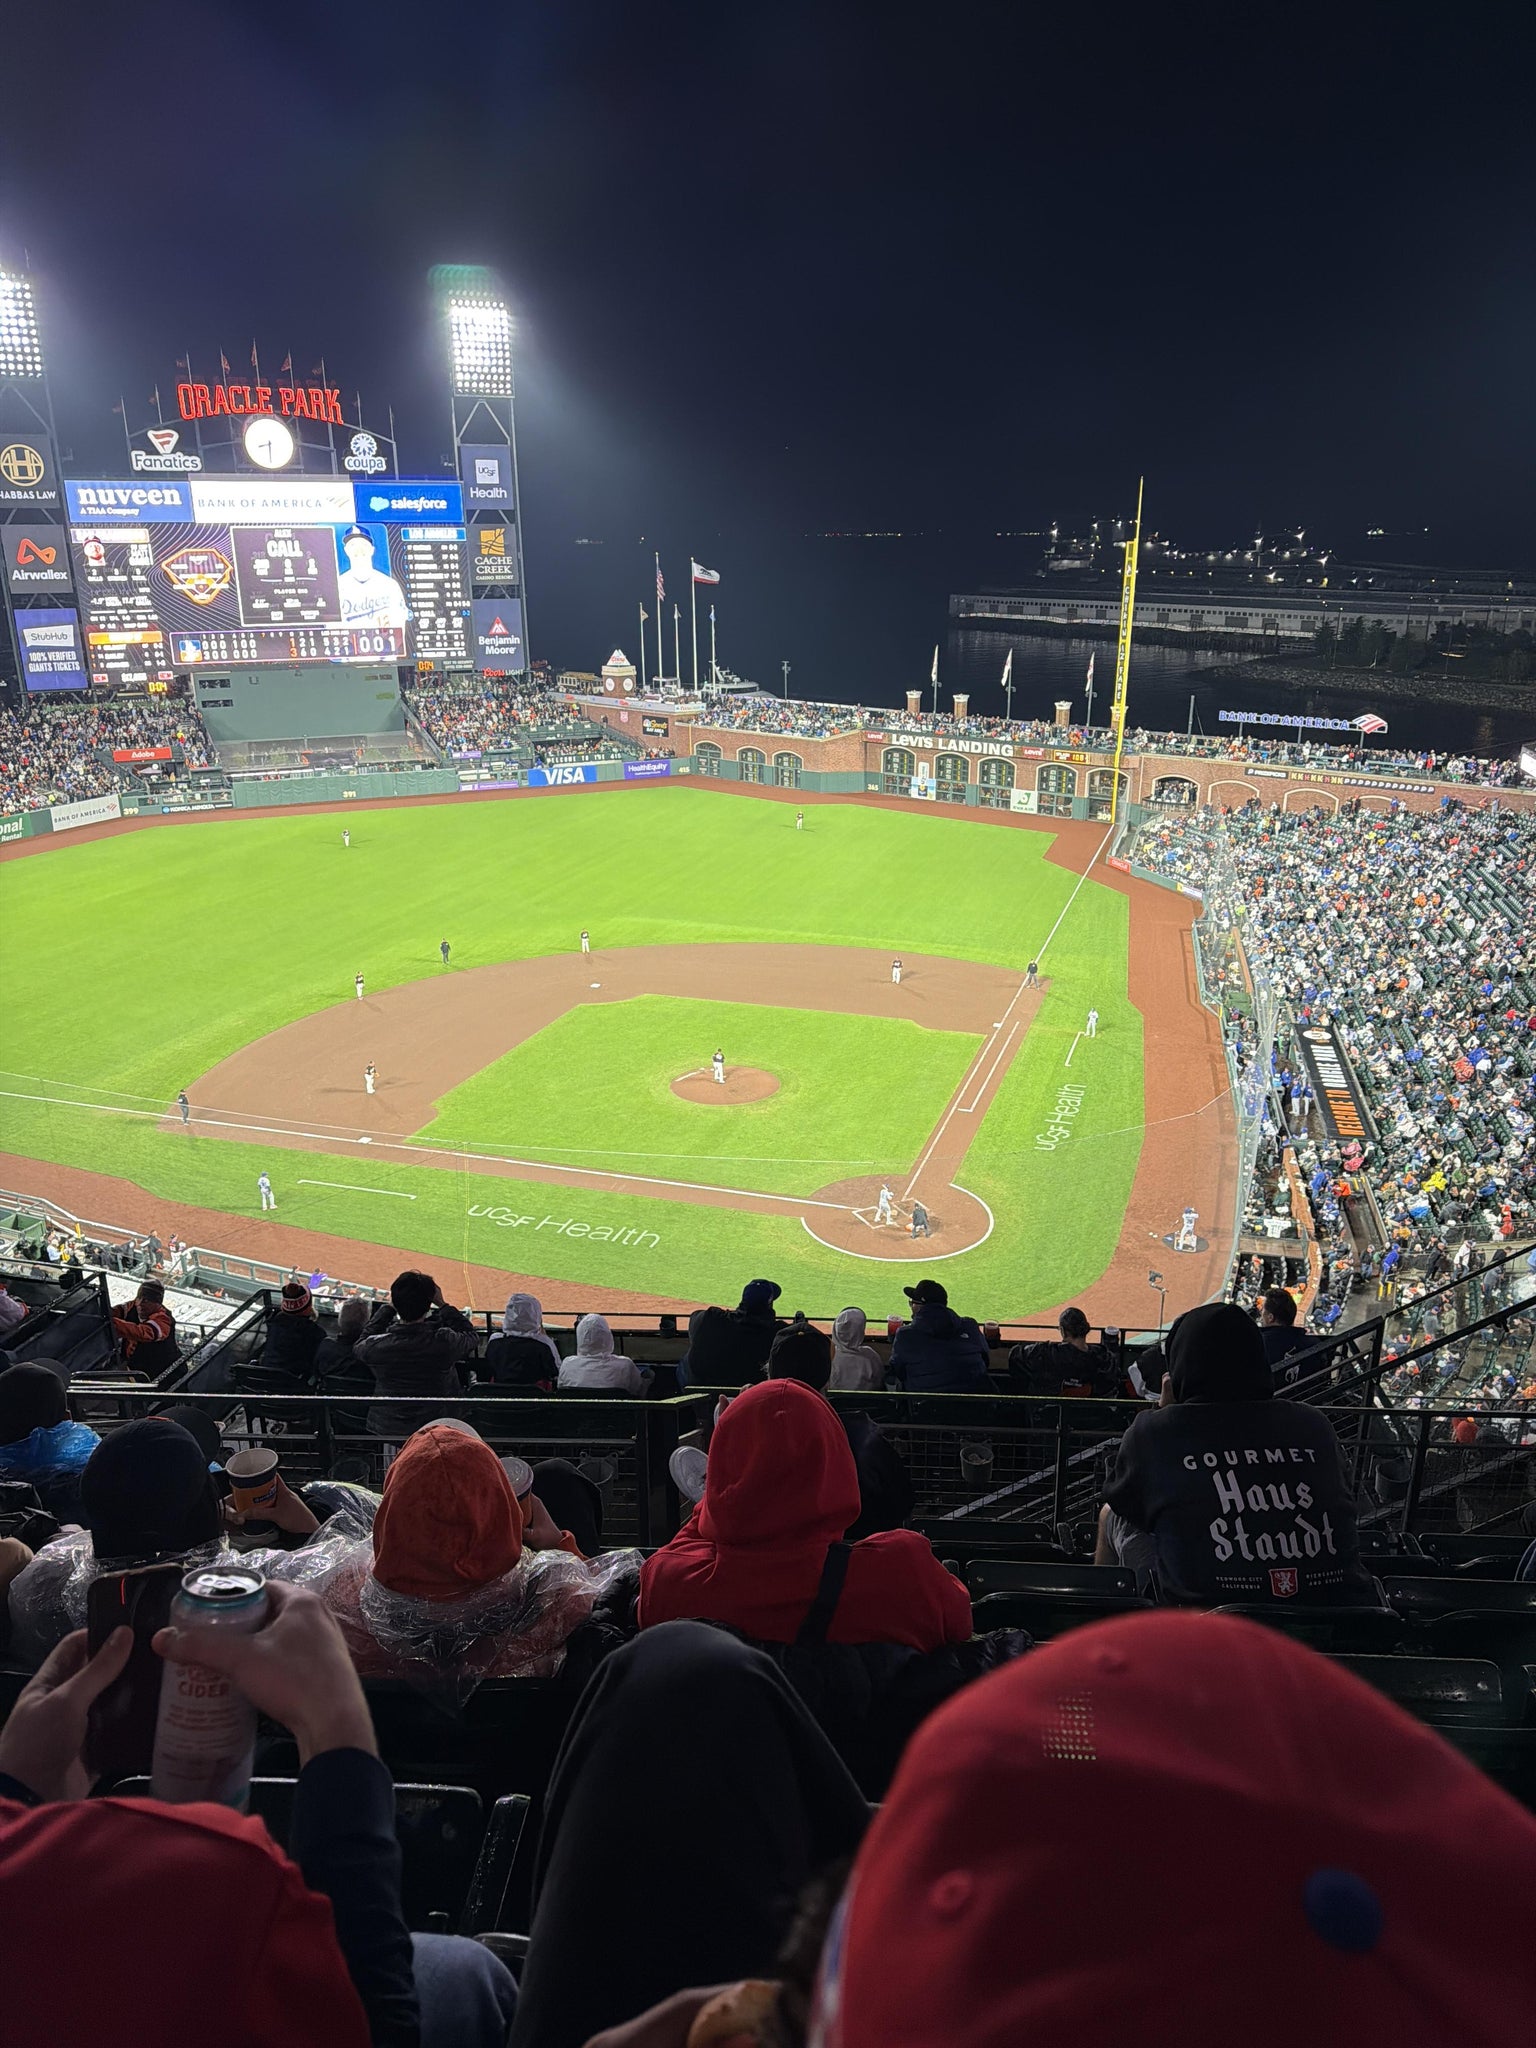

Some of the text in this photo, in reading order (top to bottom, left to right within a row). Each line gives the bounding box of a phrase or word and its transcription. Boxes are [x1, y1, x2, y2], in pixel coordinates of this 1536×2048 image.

[177, 384, 344, 425] ORACLE PARK
[134, 453, 199, 469] Fanatics
[347, 457, 384, 471] coupa
[478, 467, 496, 477] UCSF
[36, 491, 56, 499] LAW
[77, 488, 182, 505] nuveen
[470, 487, 507, 499] Health
[198, 499, 322, 508] BANK OF AMERICA
[391, 497, 447, 512] salesforce
[266, 540, 303, 557] CALL
[474, 557, 513, 565] CACHE
[12, 570, 68, 580] Airwallex
[476, 566, 512, 574] CREEK
[31, 632, 68, 641] StubHub
[478, 635, 520, 646] Benjamin
[359, 635, 396, 653] 0 0 1
[29, 651, 77, 661] 100% VERIFIED
[485, 646, 515, 655] Moore
[28, 661, 80, 673] GIANTS TICKETS
[418, 661, 434, 671] 0:04
[482, 667, 505, 677] Coors
[148, 682, 167, 692] 0:04
[1116, 666, 1124, 699] FARE
[1218, 710, 1350, 731] BANK OF AMERICA
[938, 738, 1014, 757] LANDING
[131, 751, 155, 759] Adobe
[628, 763, 668, 773] HealthEquity
[542, 767, 585, 786] VISA
[170, 804, 215, 813] KONICA MINOLTA
[54, 815, 70, 824] BANK
[80, 808, 106, 818] AMERICA
[1326, 1089, 1352, 1099] TO
[1034, 1084, 1087, 1151] UCSF Health
[467, 1204, 661, 1248] UCSF Health
[1183, 1448, 1316, 1470] GOURMET
[1212, 1469, 1314, 1515] Haus
[1209, 1512, 1337, 1562] Staudt
[178, 1680, 230, 1699] CIDER
